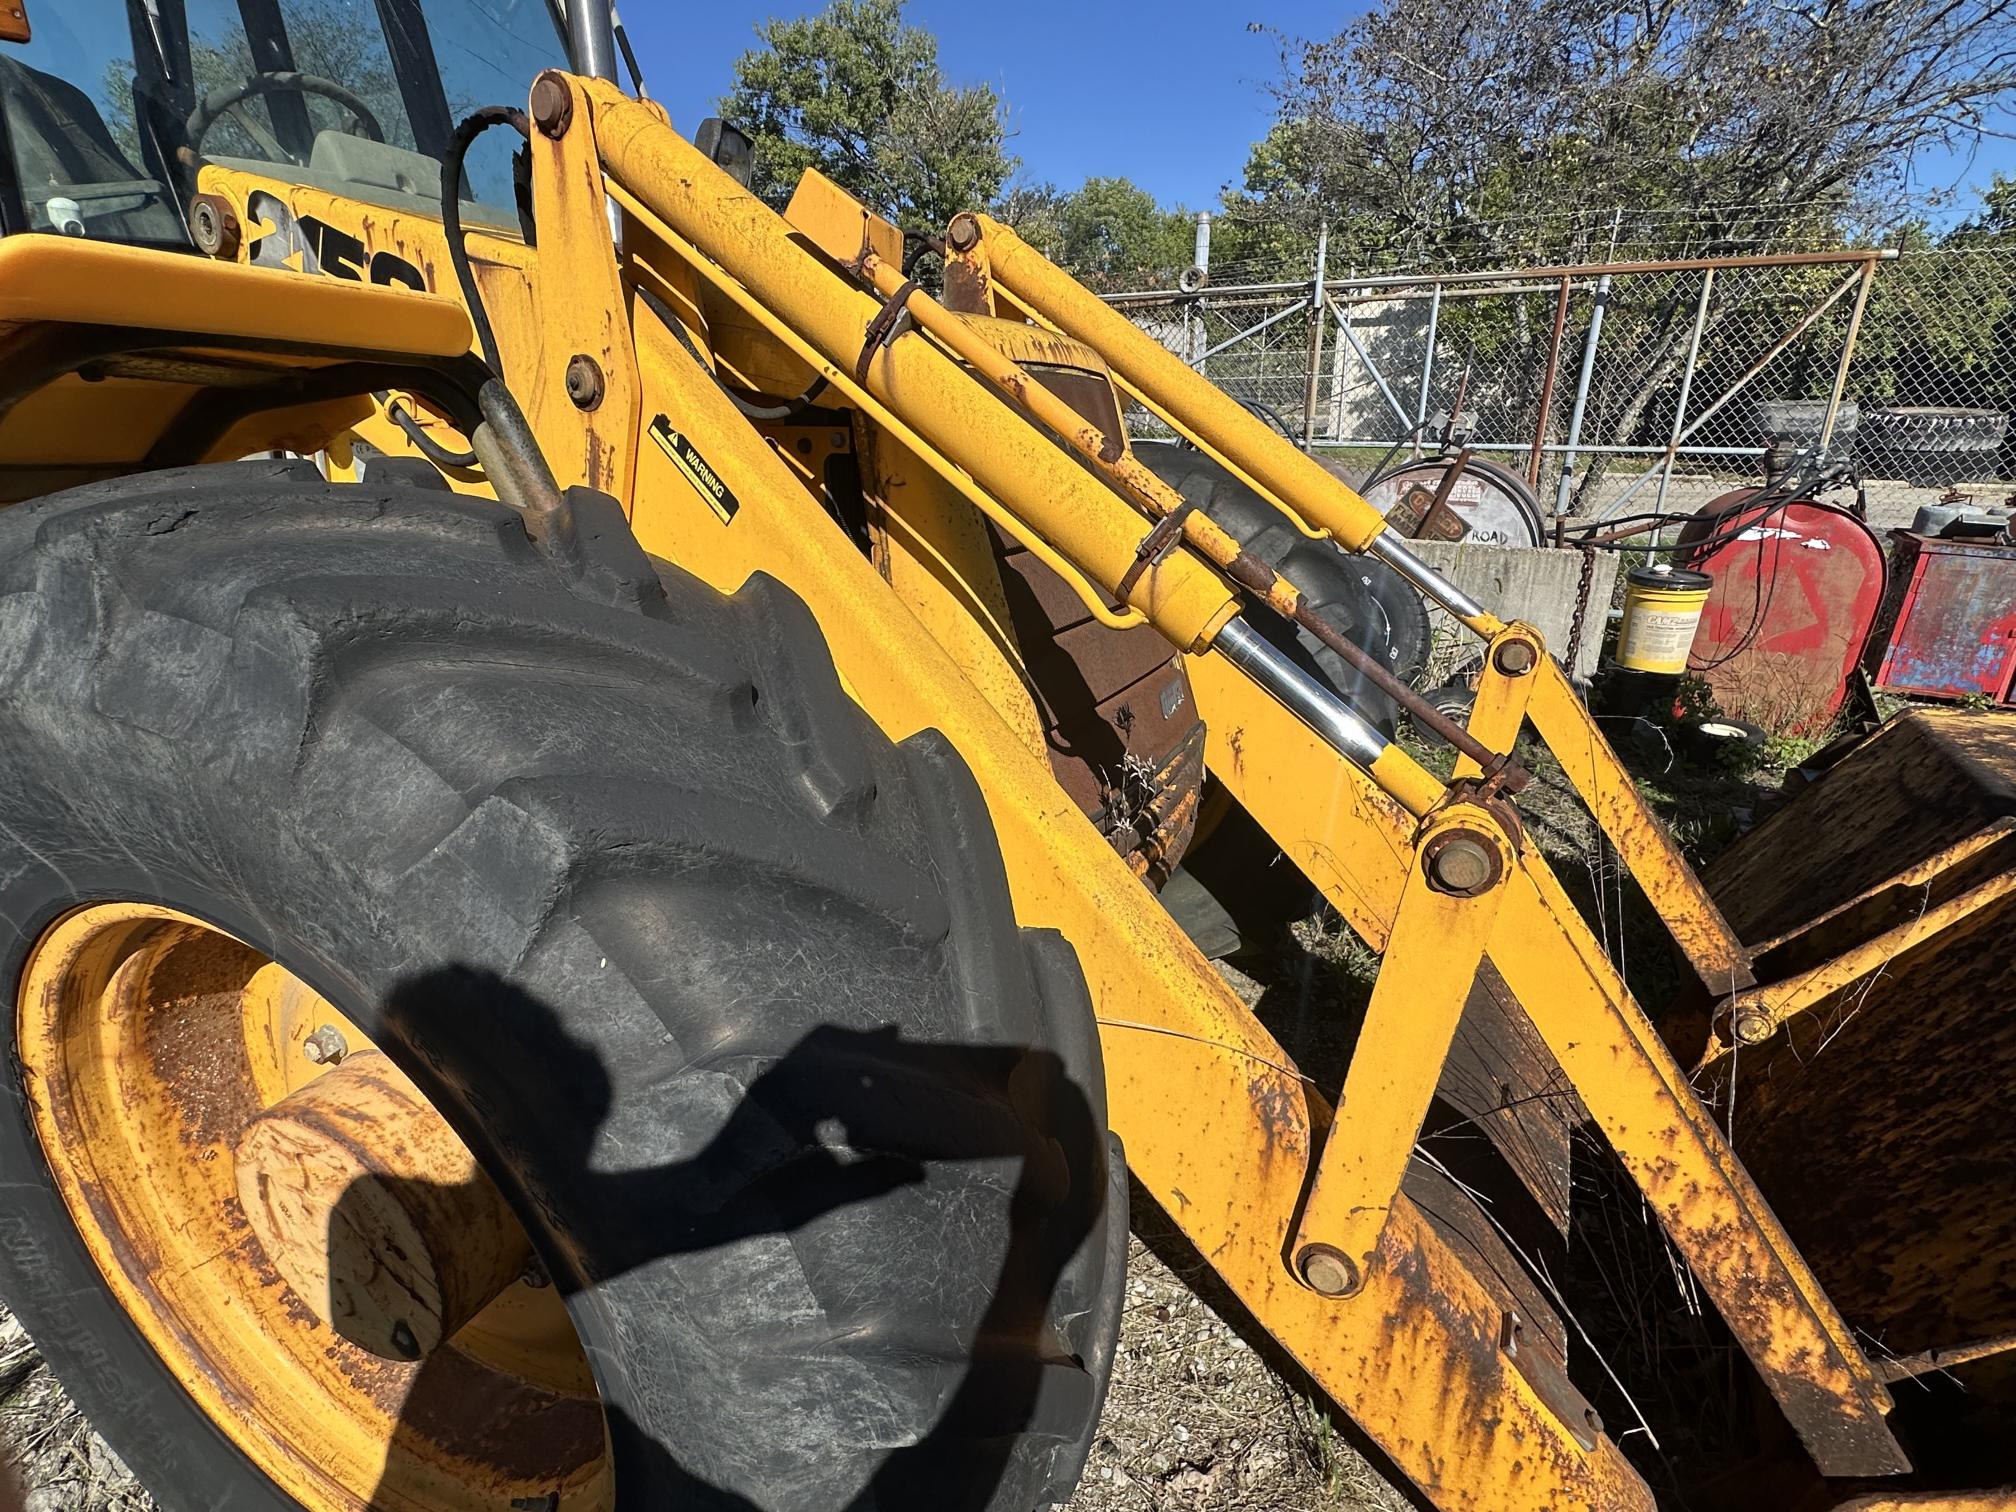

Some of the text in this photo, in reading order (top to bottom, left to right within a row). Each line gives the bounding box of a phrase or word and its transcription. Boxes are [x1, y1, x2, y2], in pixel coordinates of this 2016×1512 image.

[685, 448, 725, 498] WARNING
[1413, 493, 1461, 535] DGER
[1472, 531, 1508, 546] ROAD
